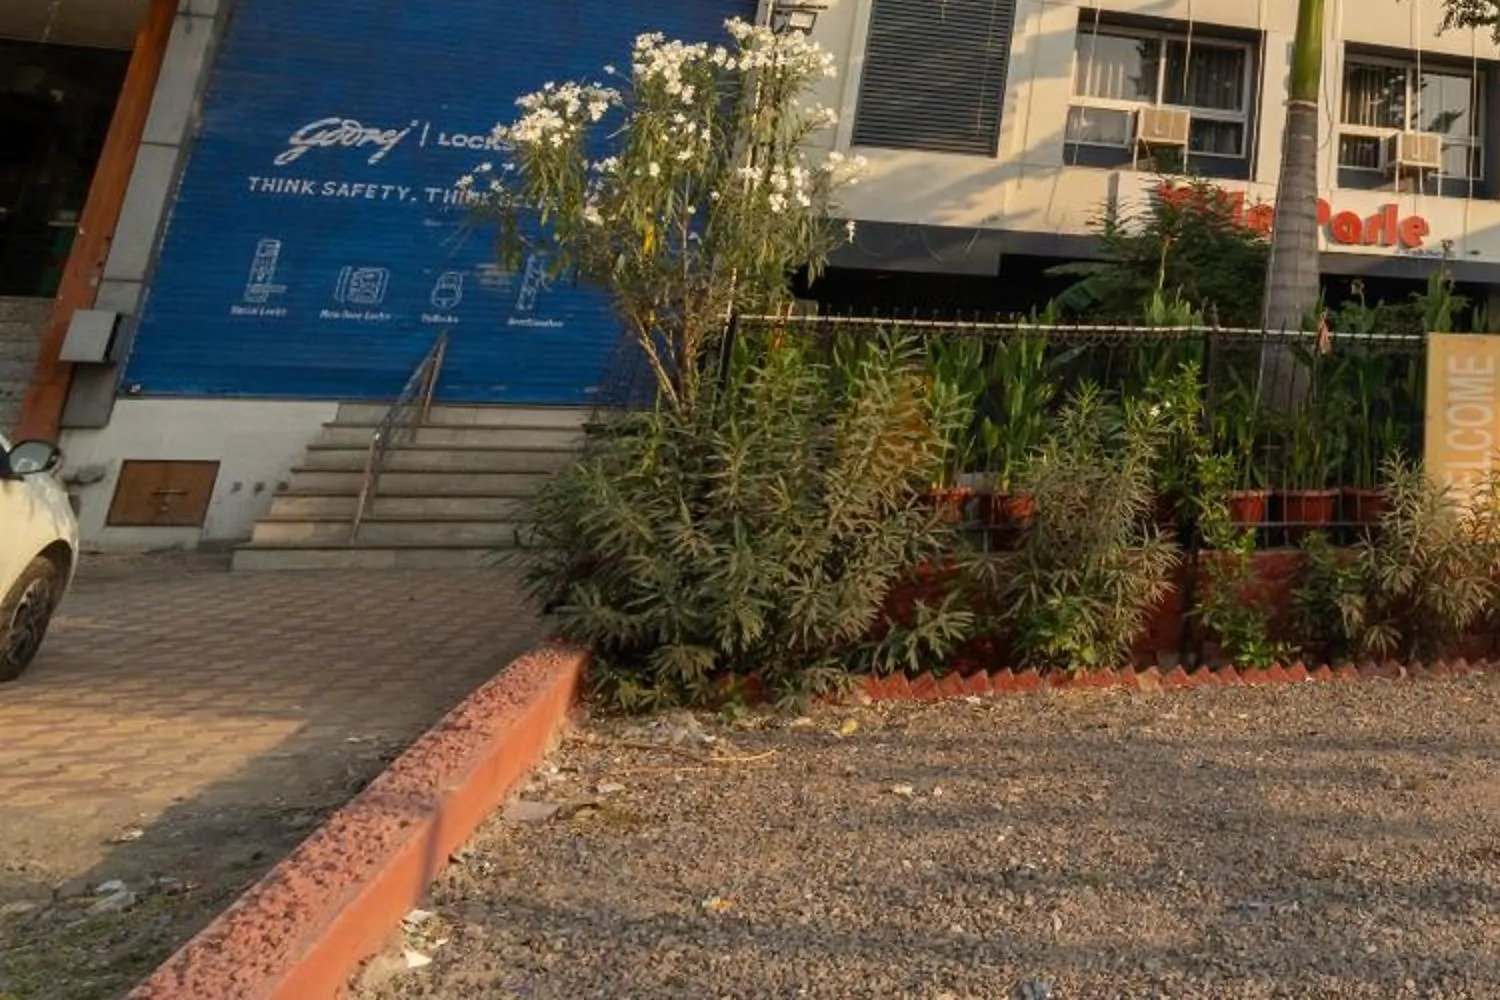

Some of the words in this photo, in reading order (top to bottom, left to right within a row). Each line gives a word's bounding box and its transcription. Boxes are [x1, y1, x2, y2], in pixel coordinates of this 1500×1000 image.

[274, 117, 419, 165] Godrej
[249, 176, 315, 195] THINK
[321, 181, 417, 203] SAFETY.
[1445, 356, 1496, 506] ELCOME
